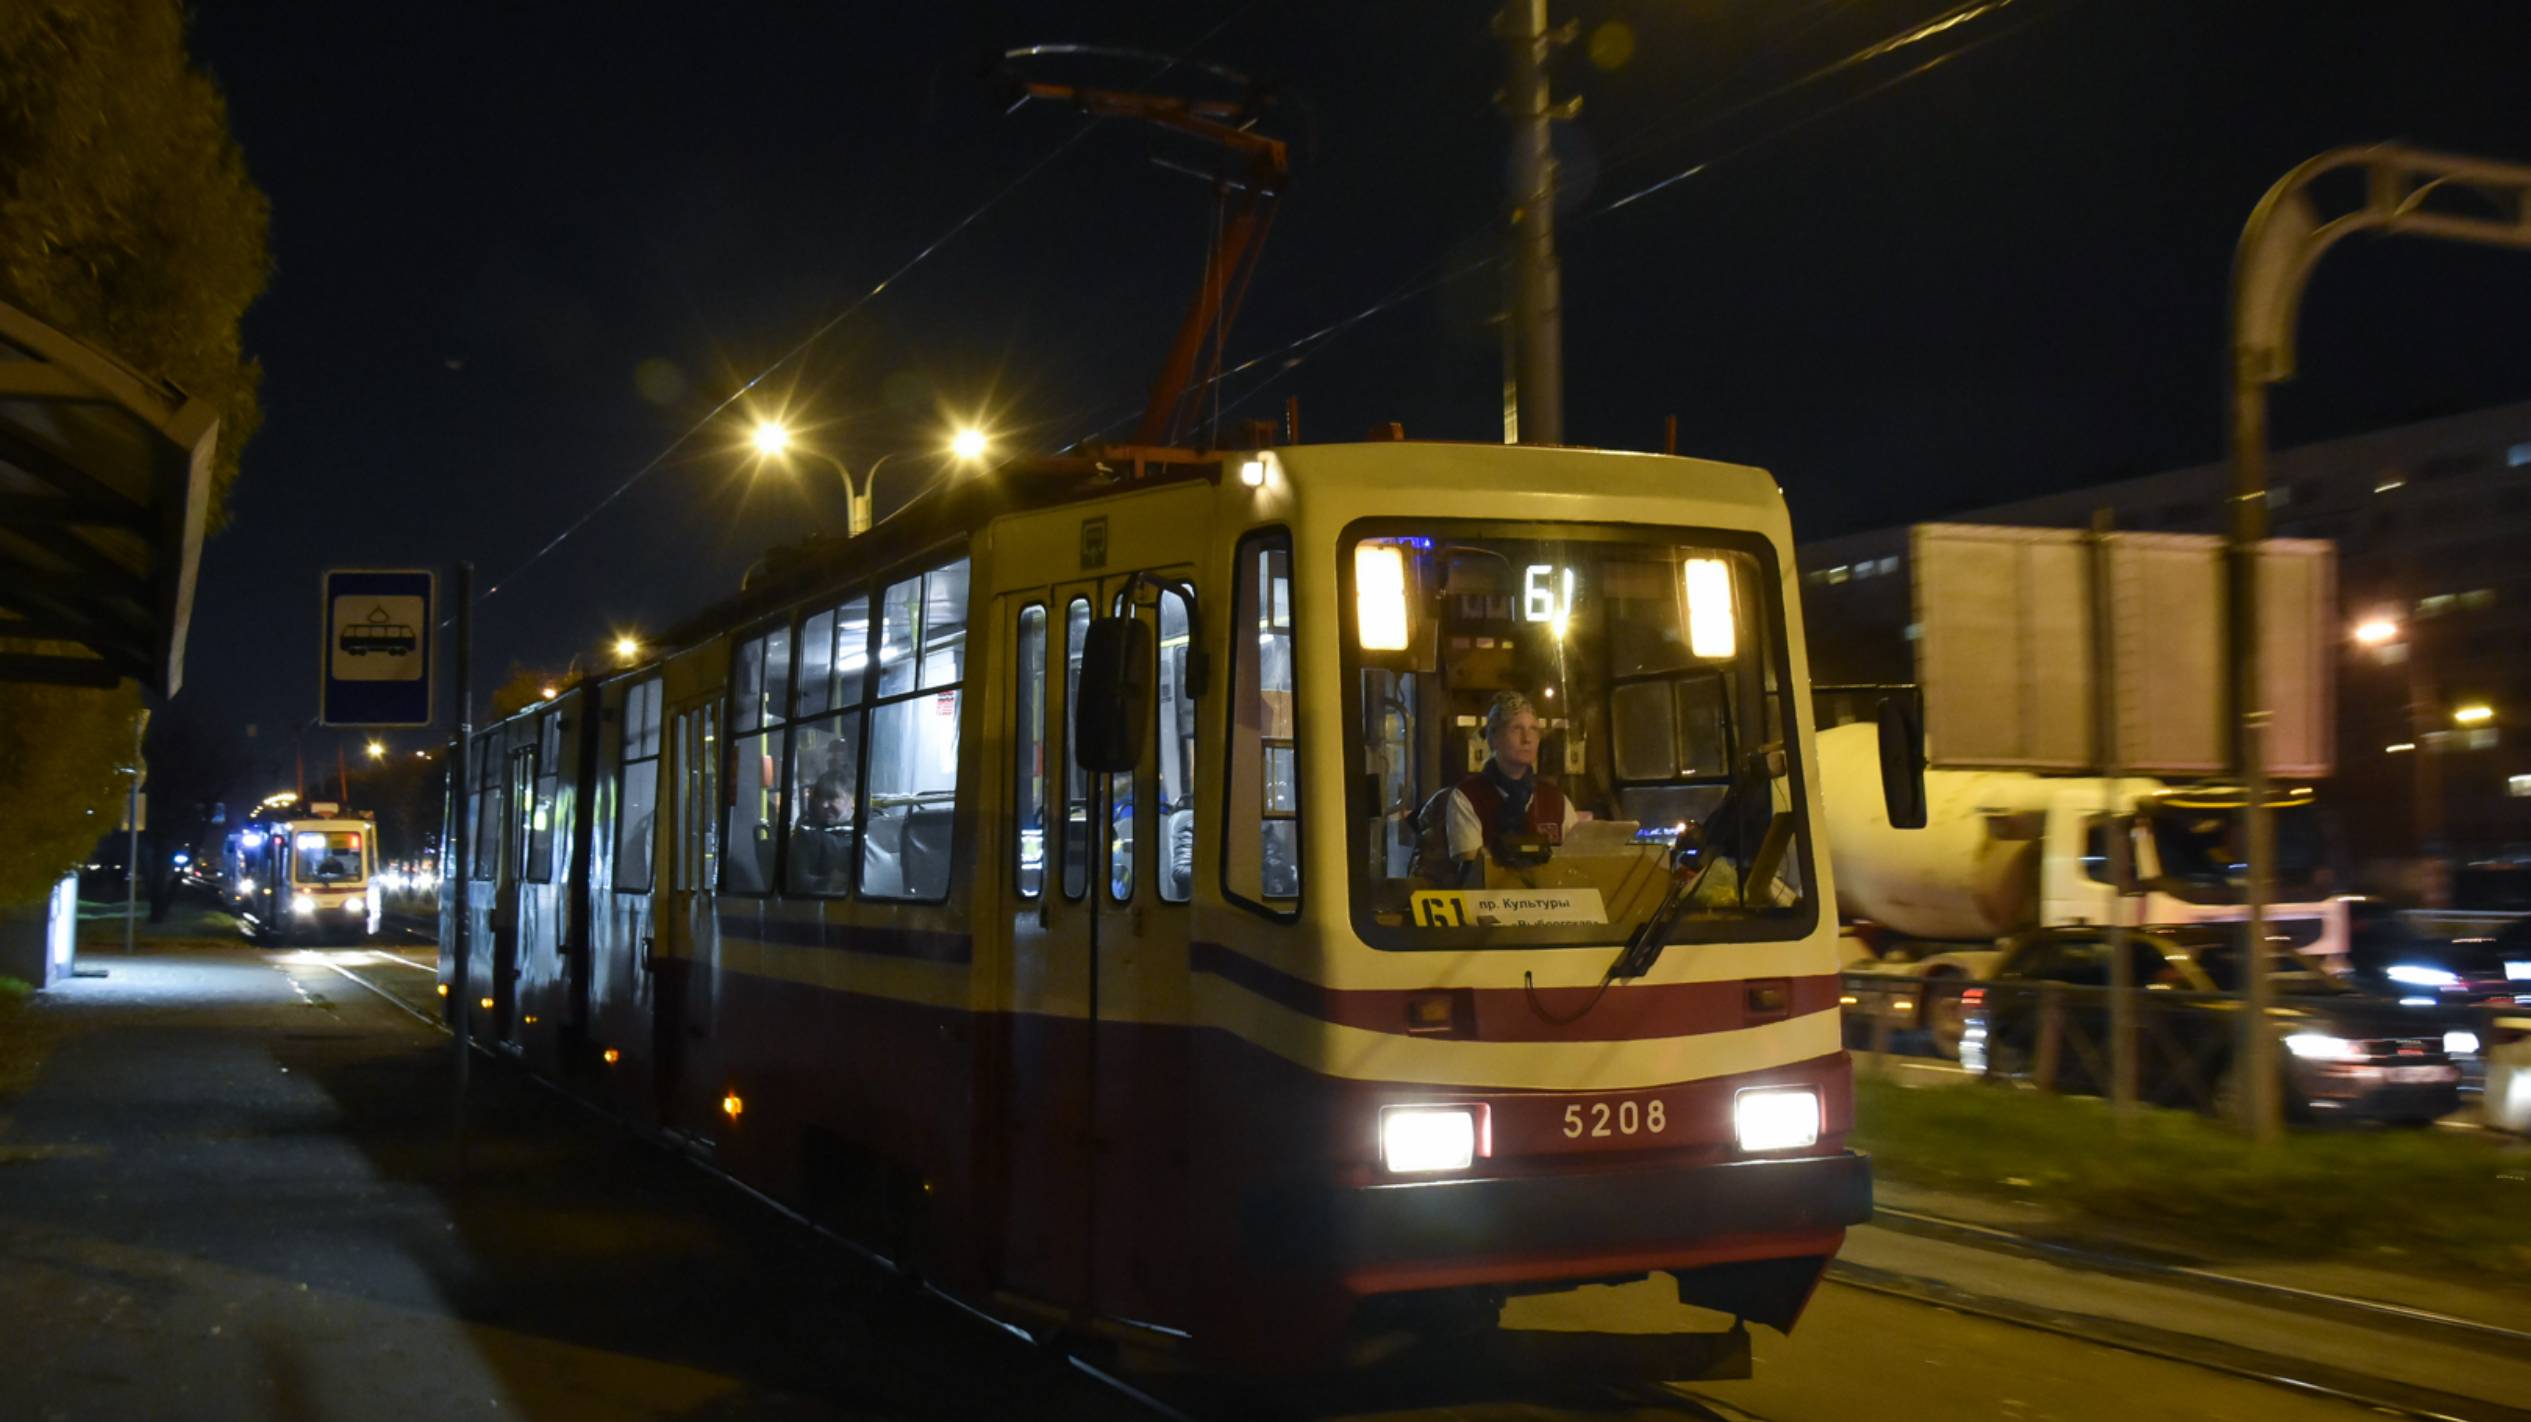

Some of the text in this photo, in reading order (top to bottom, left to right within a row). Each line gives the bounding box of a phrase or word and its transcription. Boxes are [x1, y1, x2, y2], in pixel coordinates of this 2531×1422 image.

[1524, 565, 1574, 622] 61
[1422, 898, 1466, 928] 61
[1479, 898, 1570, 911] пр. Культуры
[1563, 1099, 1666, 1138] 5208
